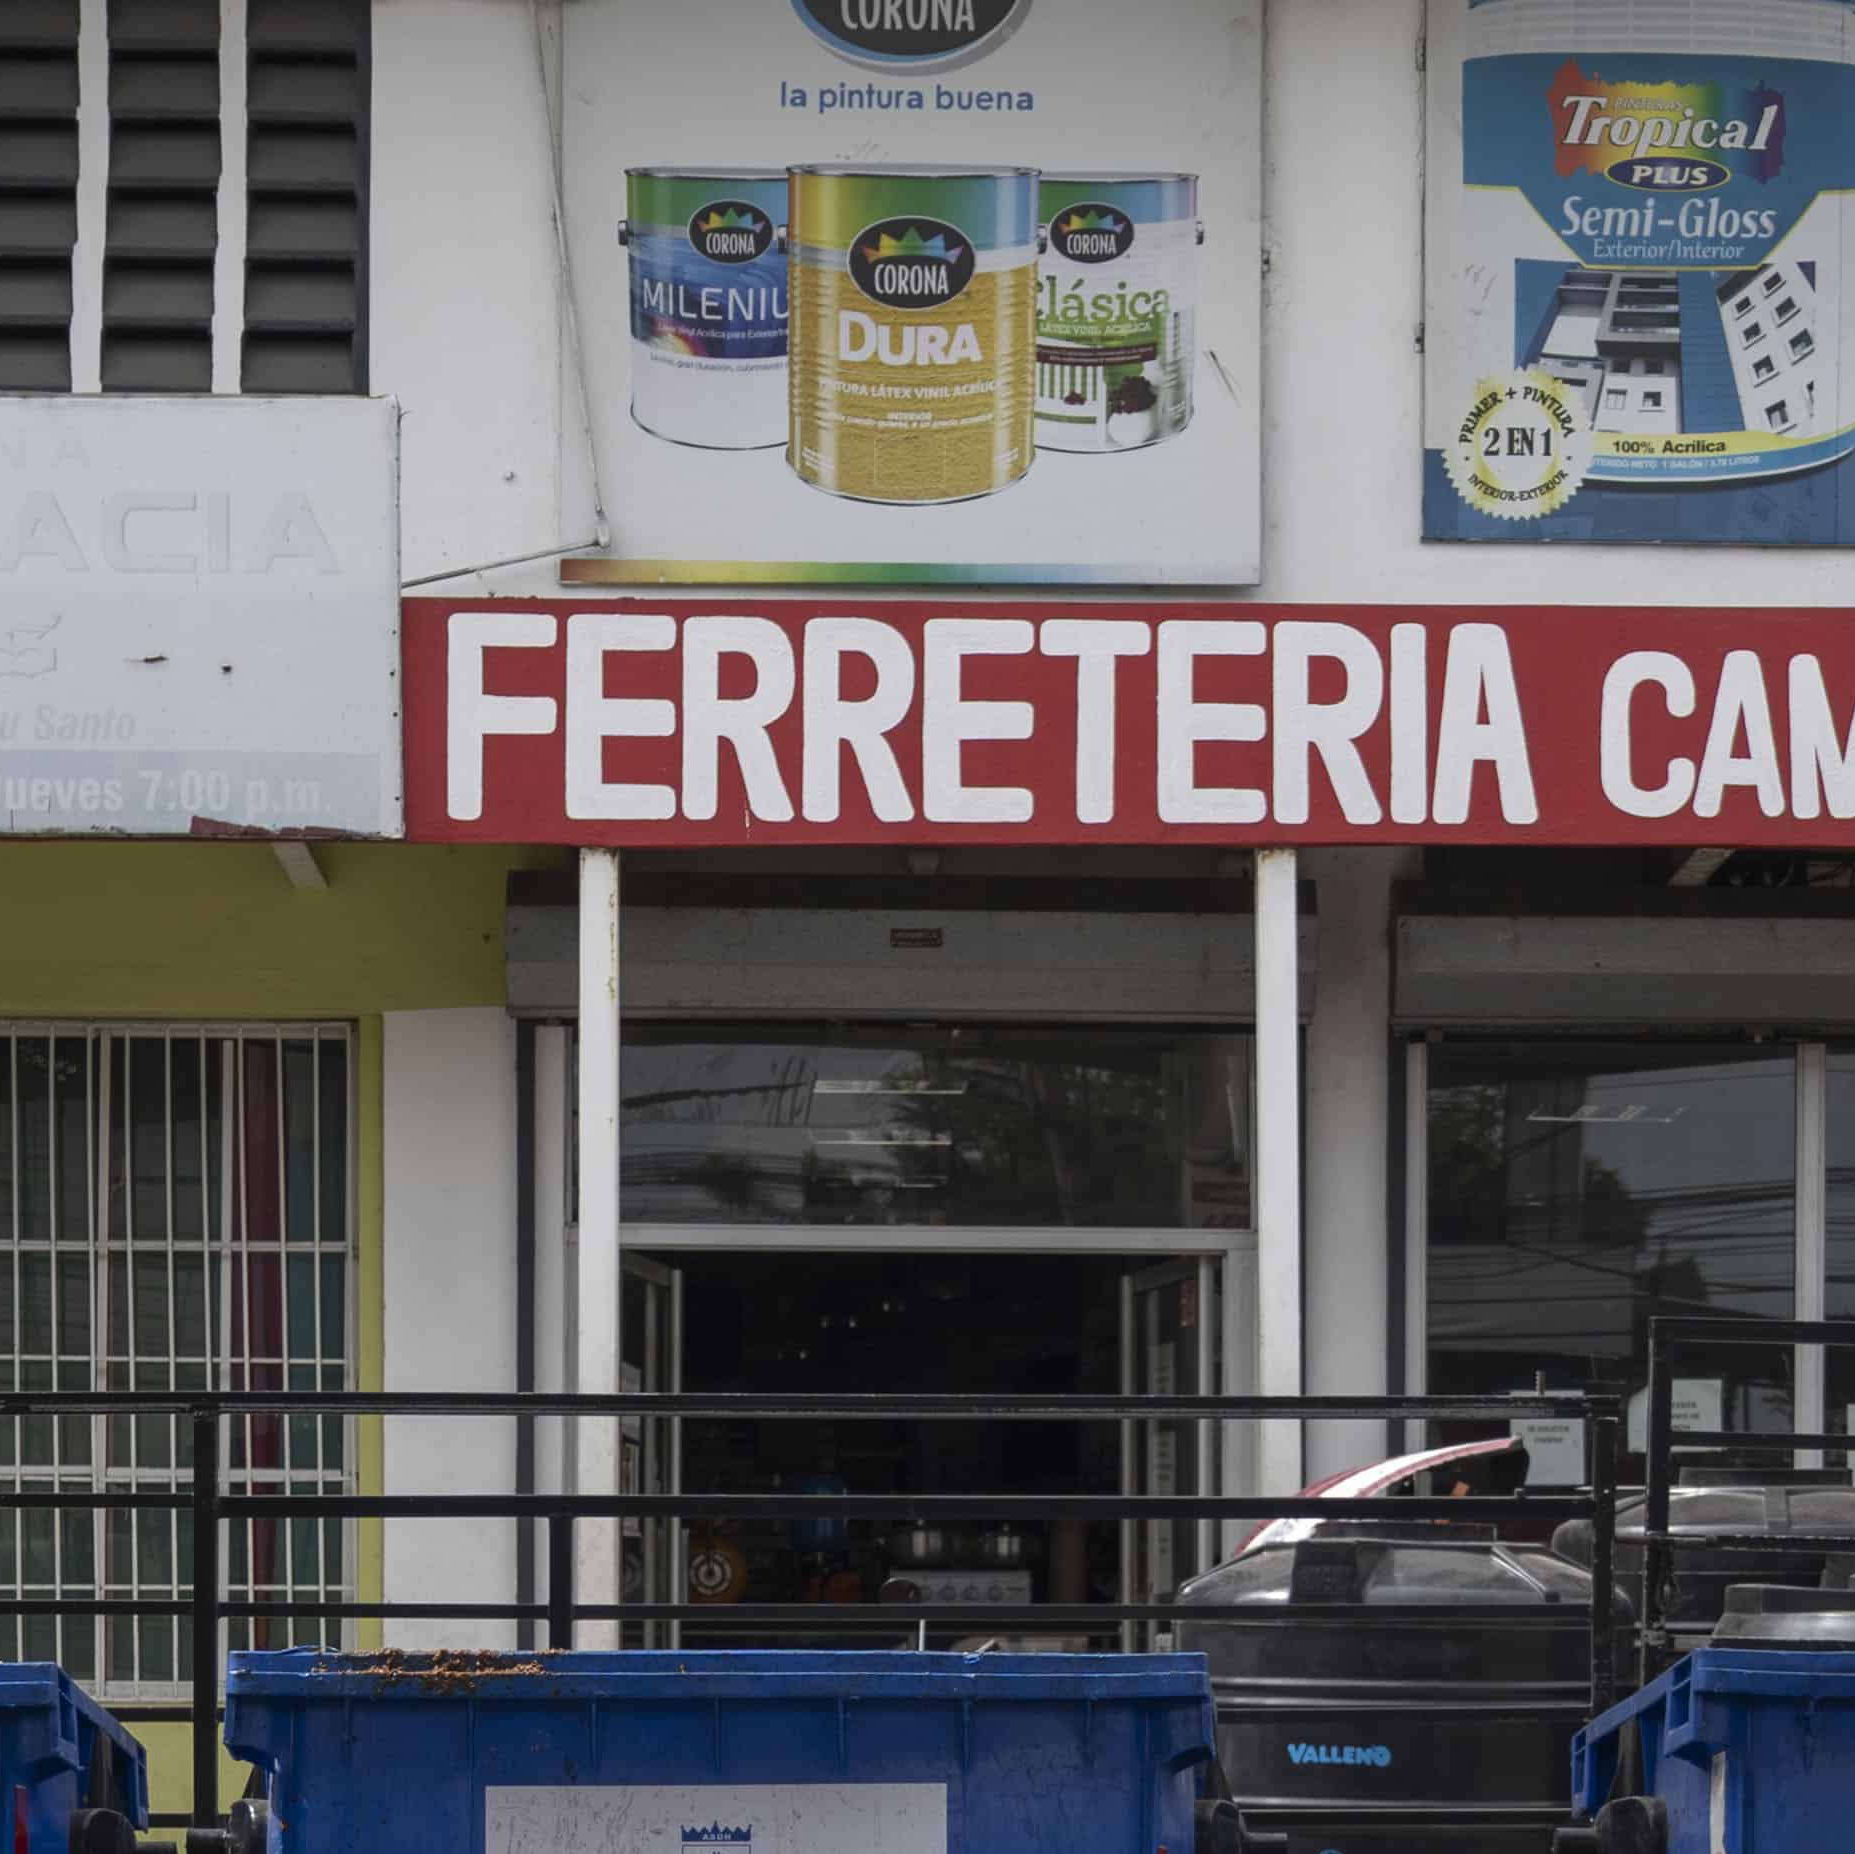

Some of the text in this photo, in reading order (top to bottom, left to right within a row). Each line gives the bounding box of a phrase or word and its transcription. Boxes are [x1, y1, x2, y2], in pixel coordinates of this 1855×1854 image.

[840, 0, 975, 31] CORONA
[780, 81, 1034, 114] la pintura buena
[1562, 95, 1779, 159] Tropical
[1632, 165, 1708, 184] PLUS
[1561, 195, 1777, 239] Semi-Gloss
[706, 233, 755, 255] CORONA
[1066, 234, 1117, 256] CORONA
[1593, 239, 1745, 260] Exterior/Interior
[874, 264, 949, 296] CORONA
[838, 310, 984, 366] DURA
[1458, 391, 1503, 444] PRIMER
[1522, 386, 1577, 439] PINTURA
[1483, 427, 1552, 457] 2 EN 1
[1612, 440, 1655, 455] 100%
[446, 612, 1539, 826] FERRETERIA
[138, 769, 230, 812] 7:00
